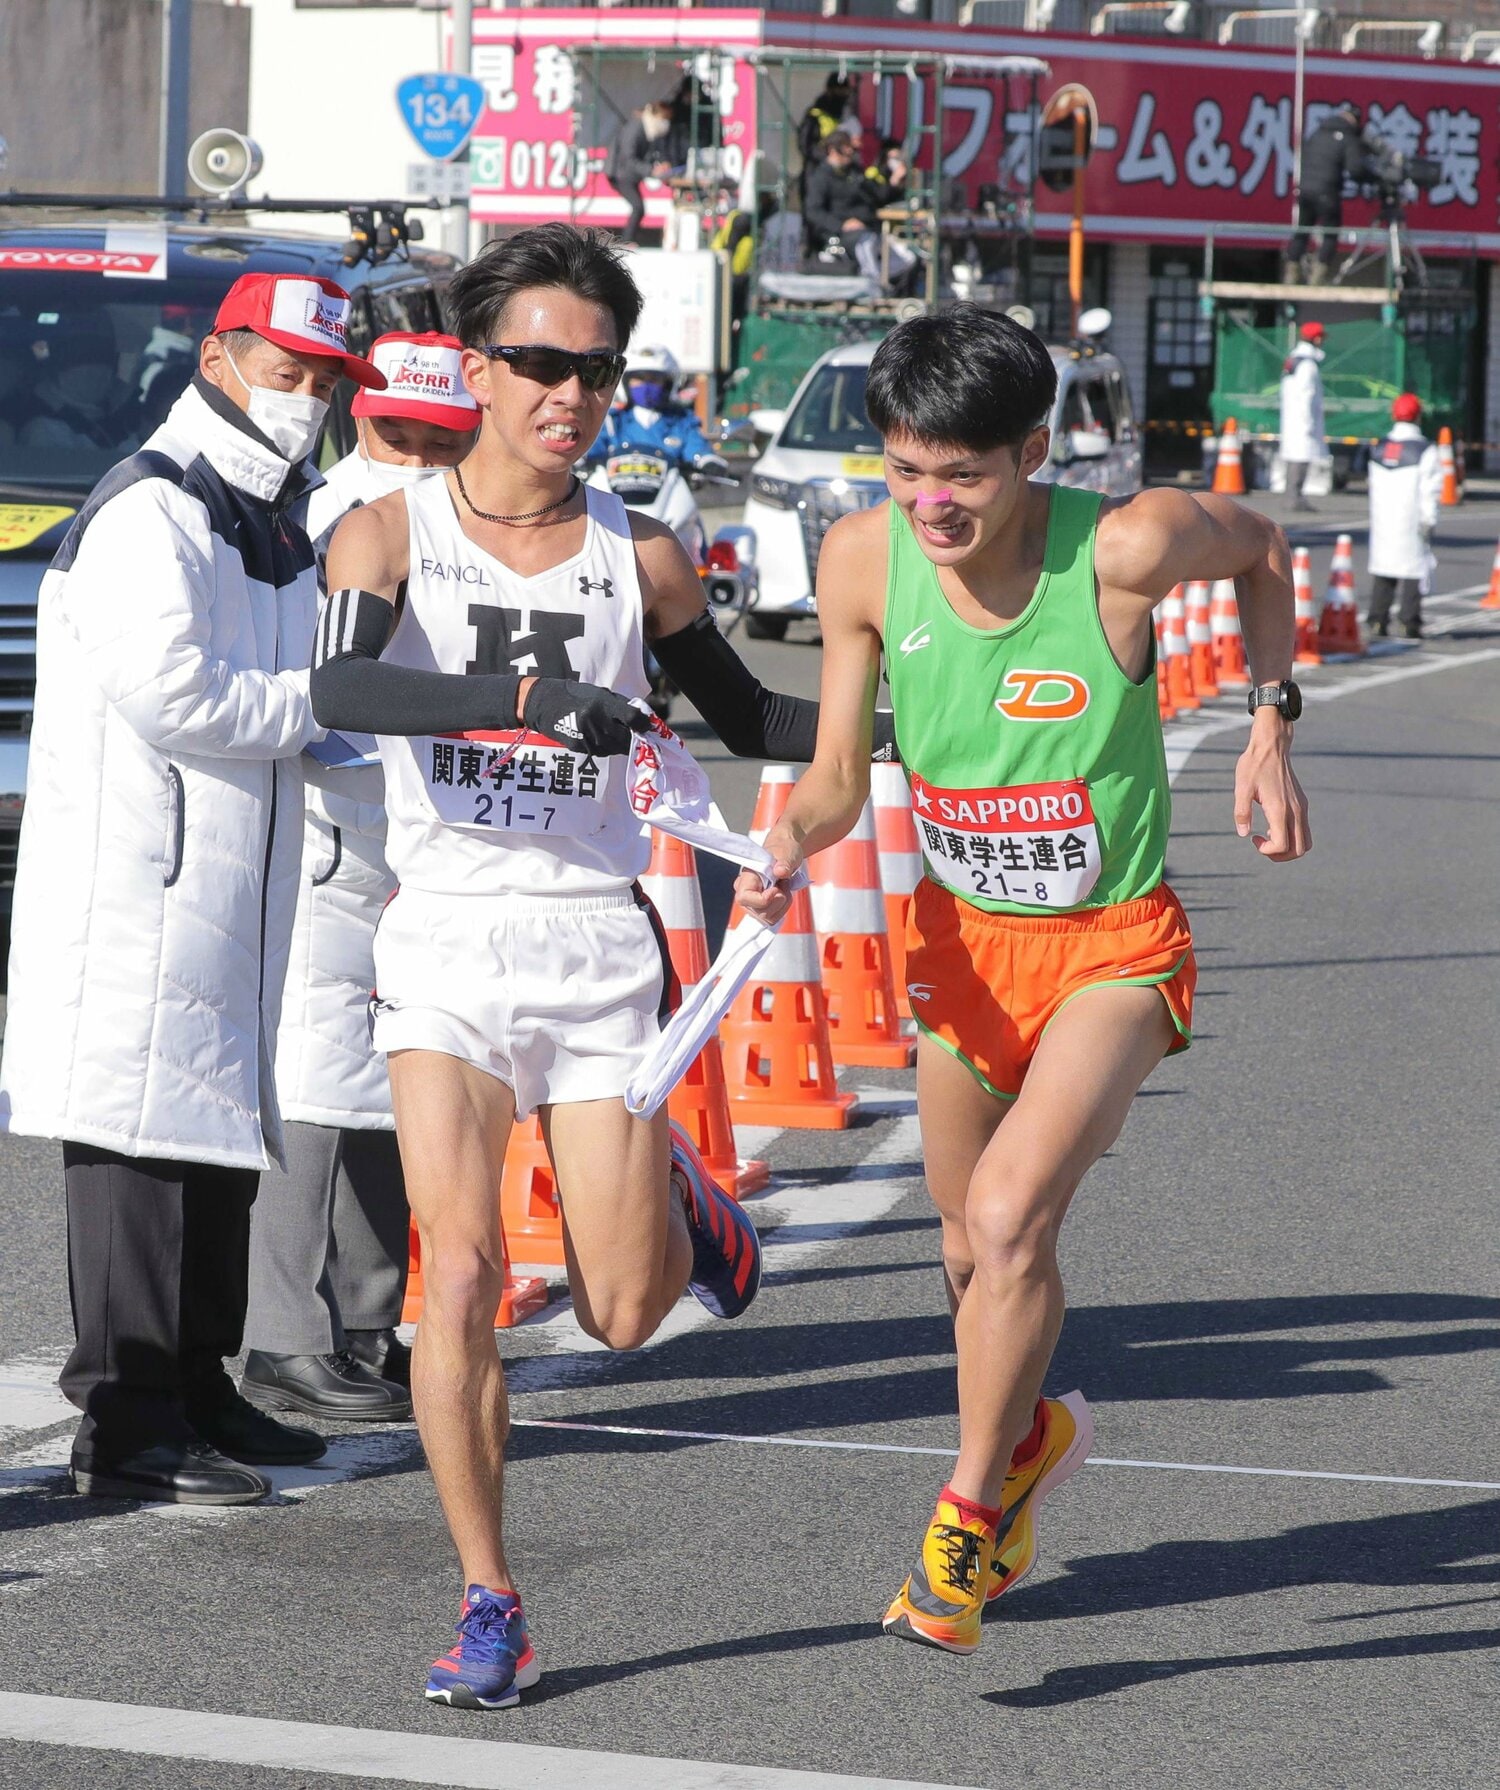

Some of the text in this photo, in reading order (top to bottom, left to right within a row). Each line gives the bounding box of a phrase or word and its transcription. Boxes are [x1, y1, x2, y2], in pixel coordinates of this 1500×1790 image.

[408, 93, 473, 127] 134
[421, 559, 490, 586] FANCL
[466, 603, 585, 682] K
[995, 669, 1090, 721] D
[554, 724, 584, 740] adidas
[432, 742, 600, 798] 関東学生連合
[940, 792, 1083, 824] SAPPORO
[921, 820, 1087, 872] 関東学生連合
[971, 870, 1048, 901] 21-8
